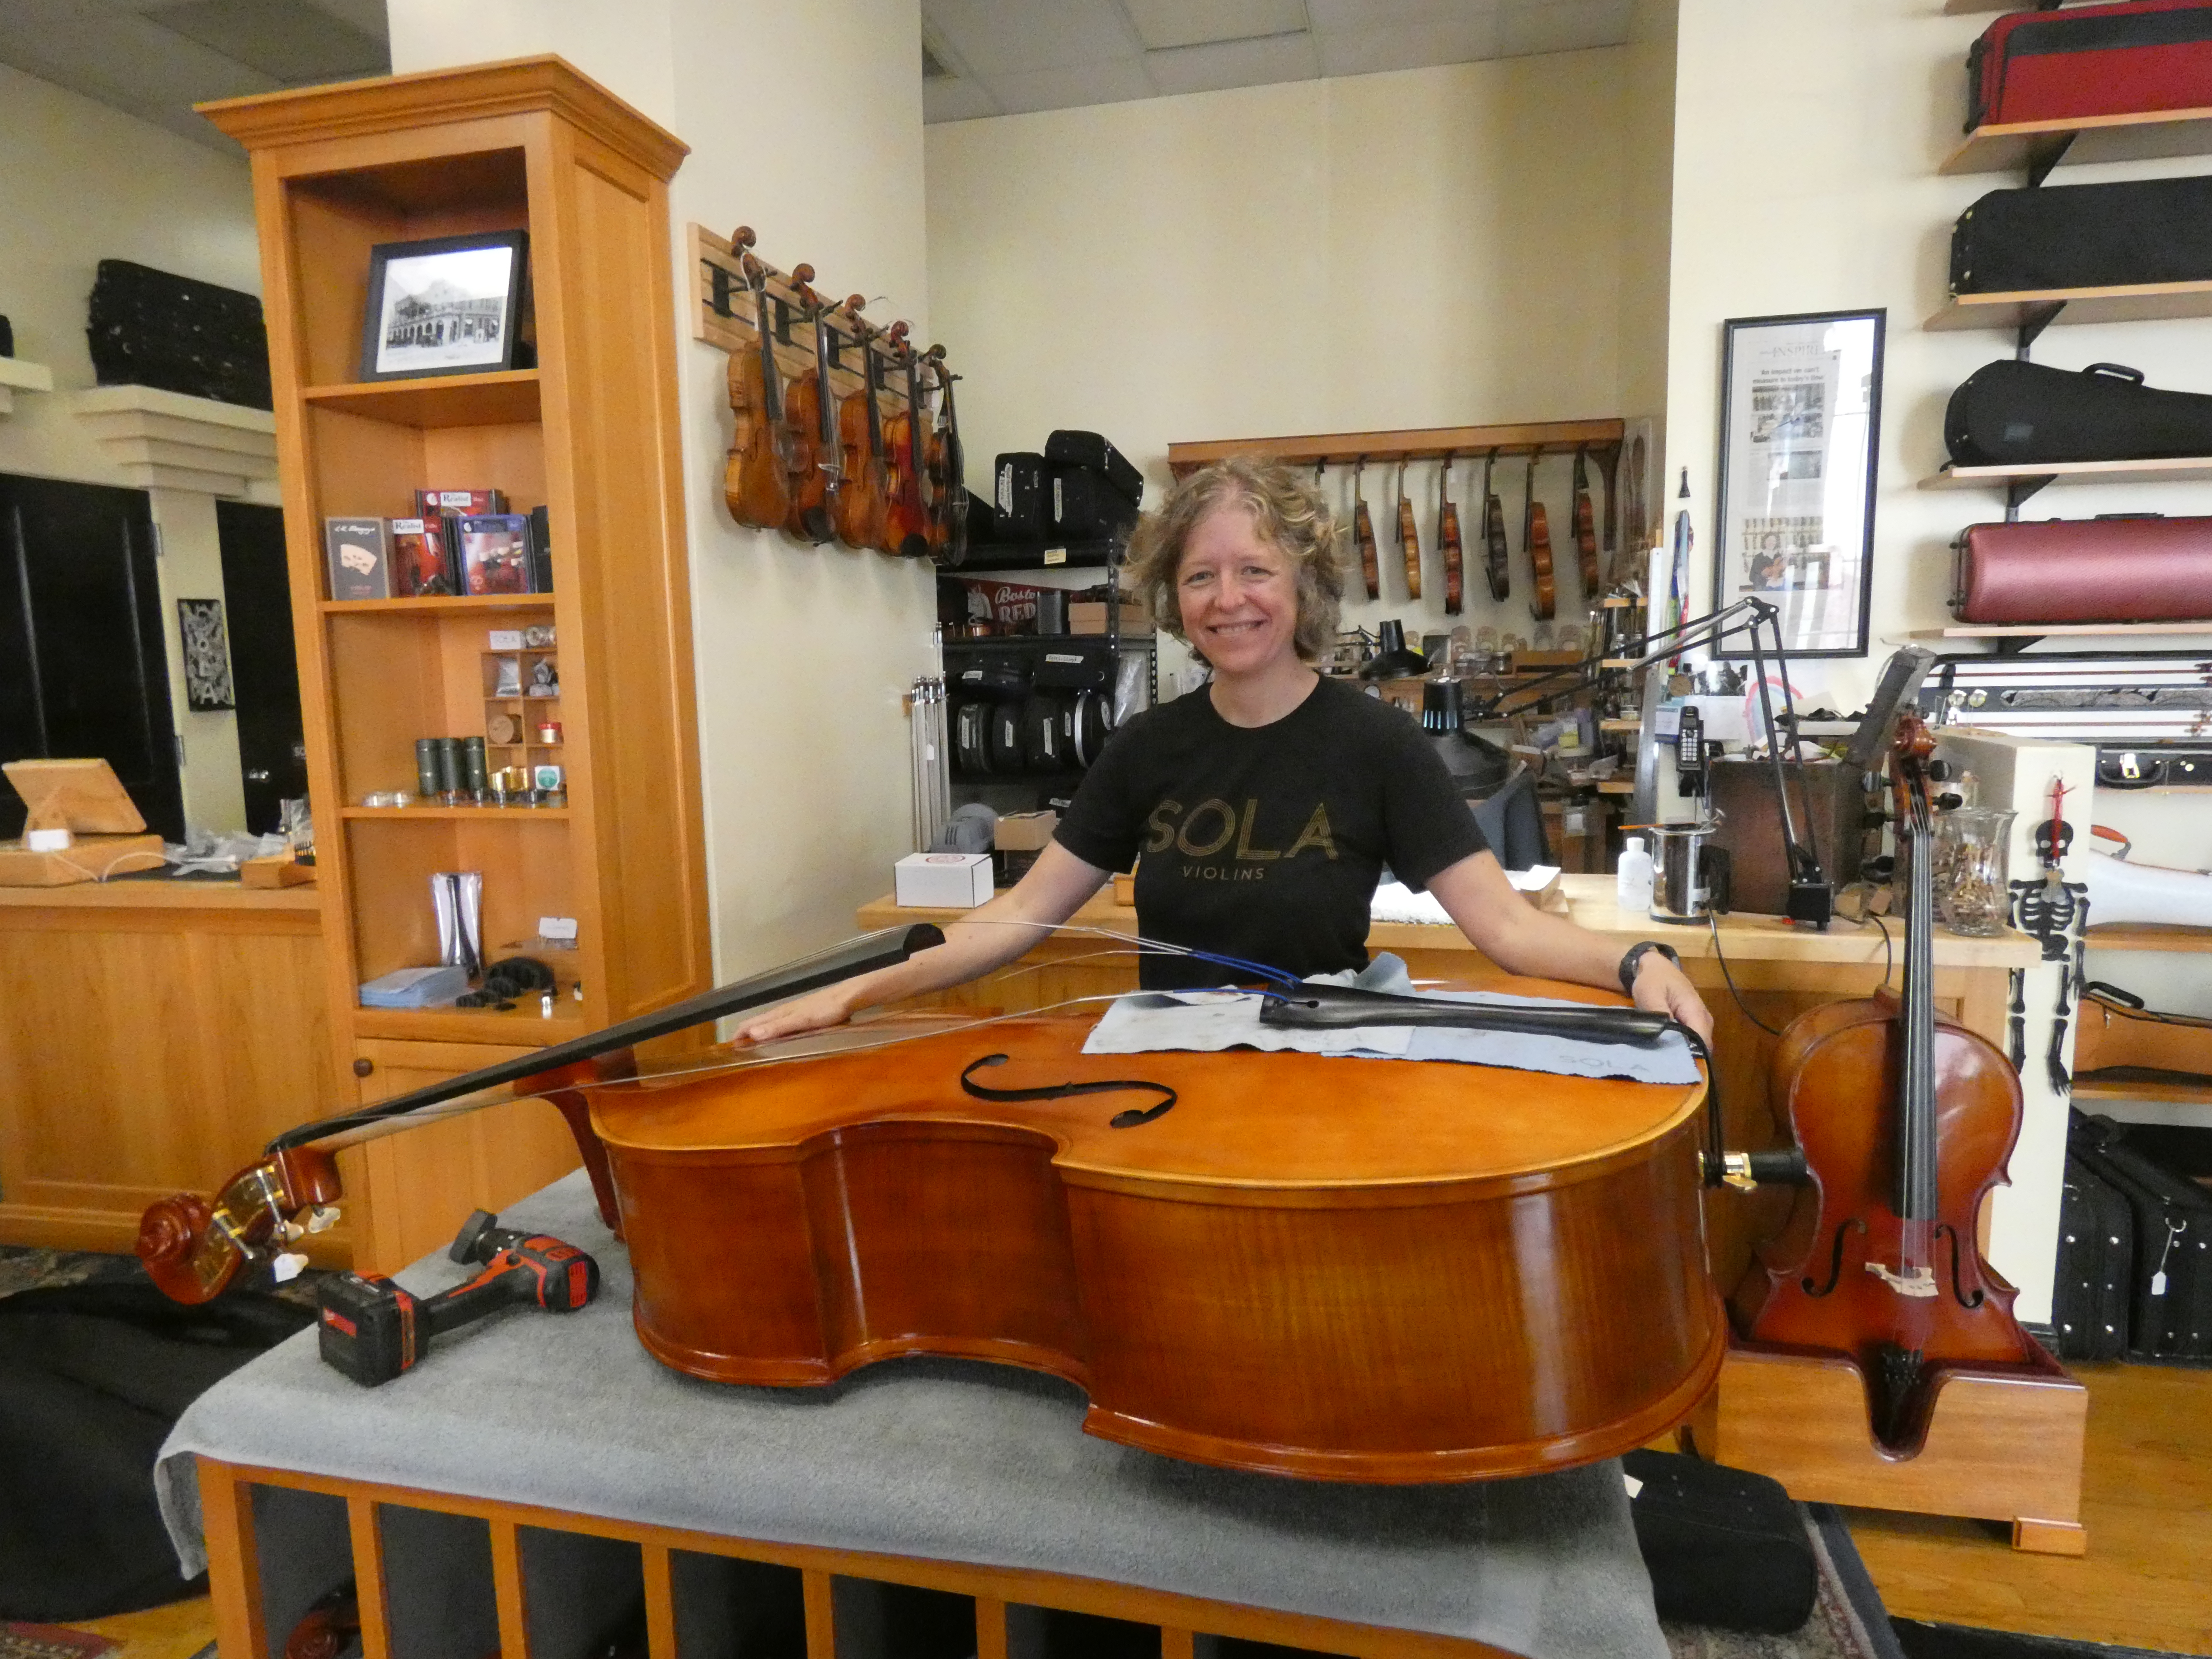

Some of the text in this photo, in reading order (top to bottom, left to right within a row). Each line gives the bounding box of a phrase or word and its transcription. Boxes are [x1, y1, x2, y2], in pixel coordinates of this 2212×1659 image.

[396, 522, 421, 530] Realist
[995, 586, 1036, 605] Bosto
[998, 603, 1036, 623] RED
[1147, 799, 1339, 860] SOLA
[1183, 866, 1265, 881] VIOLINS
